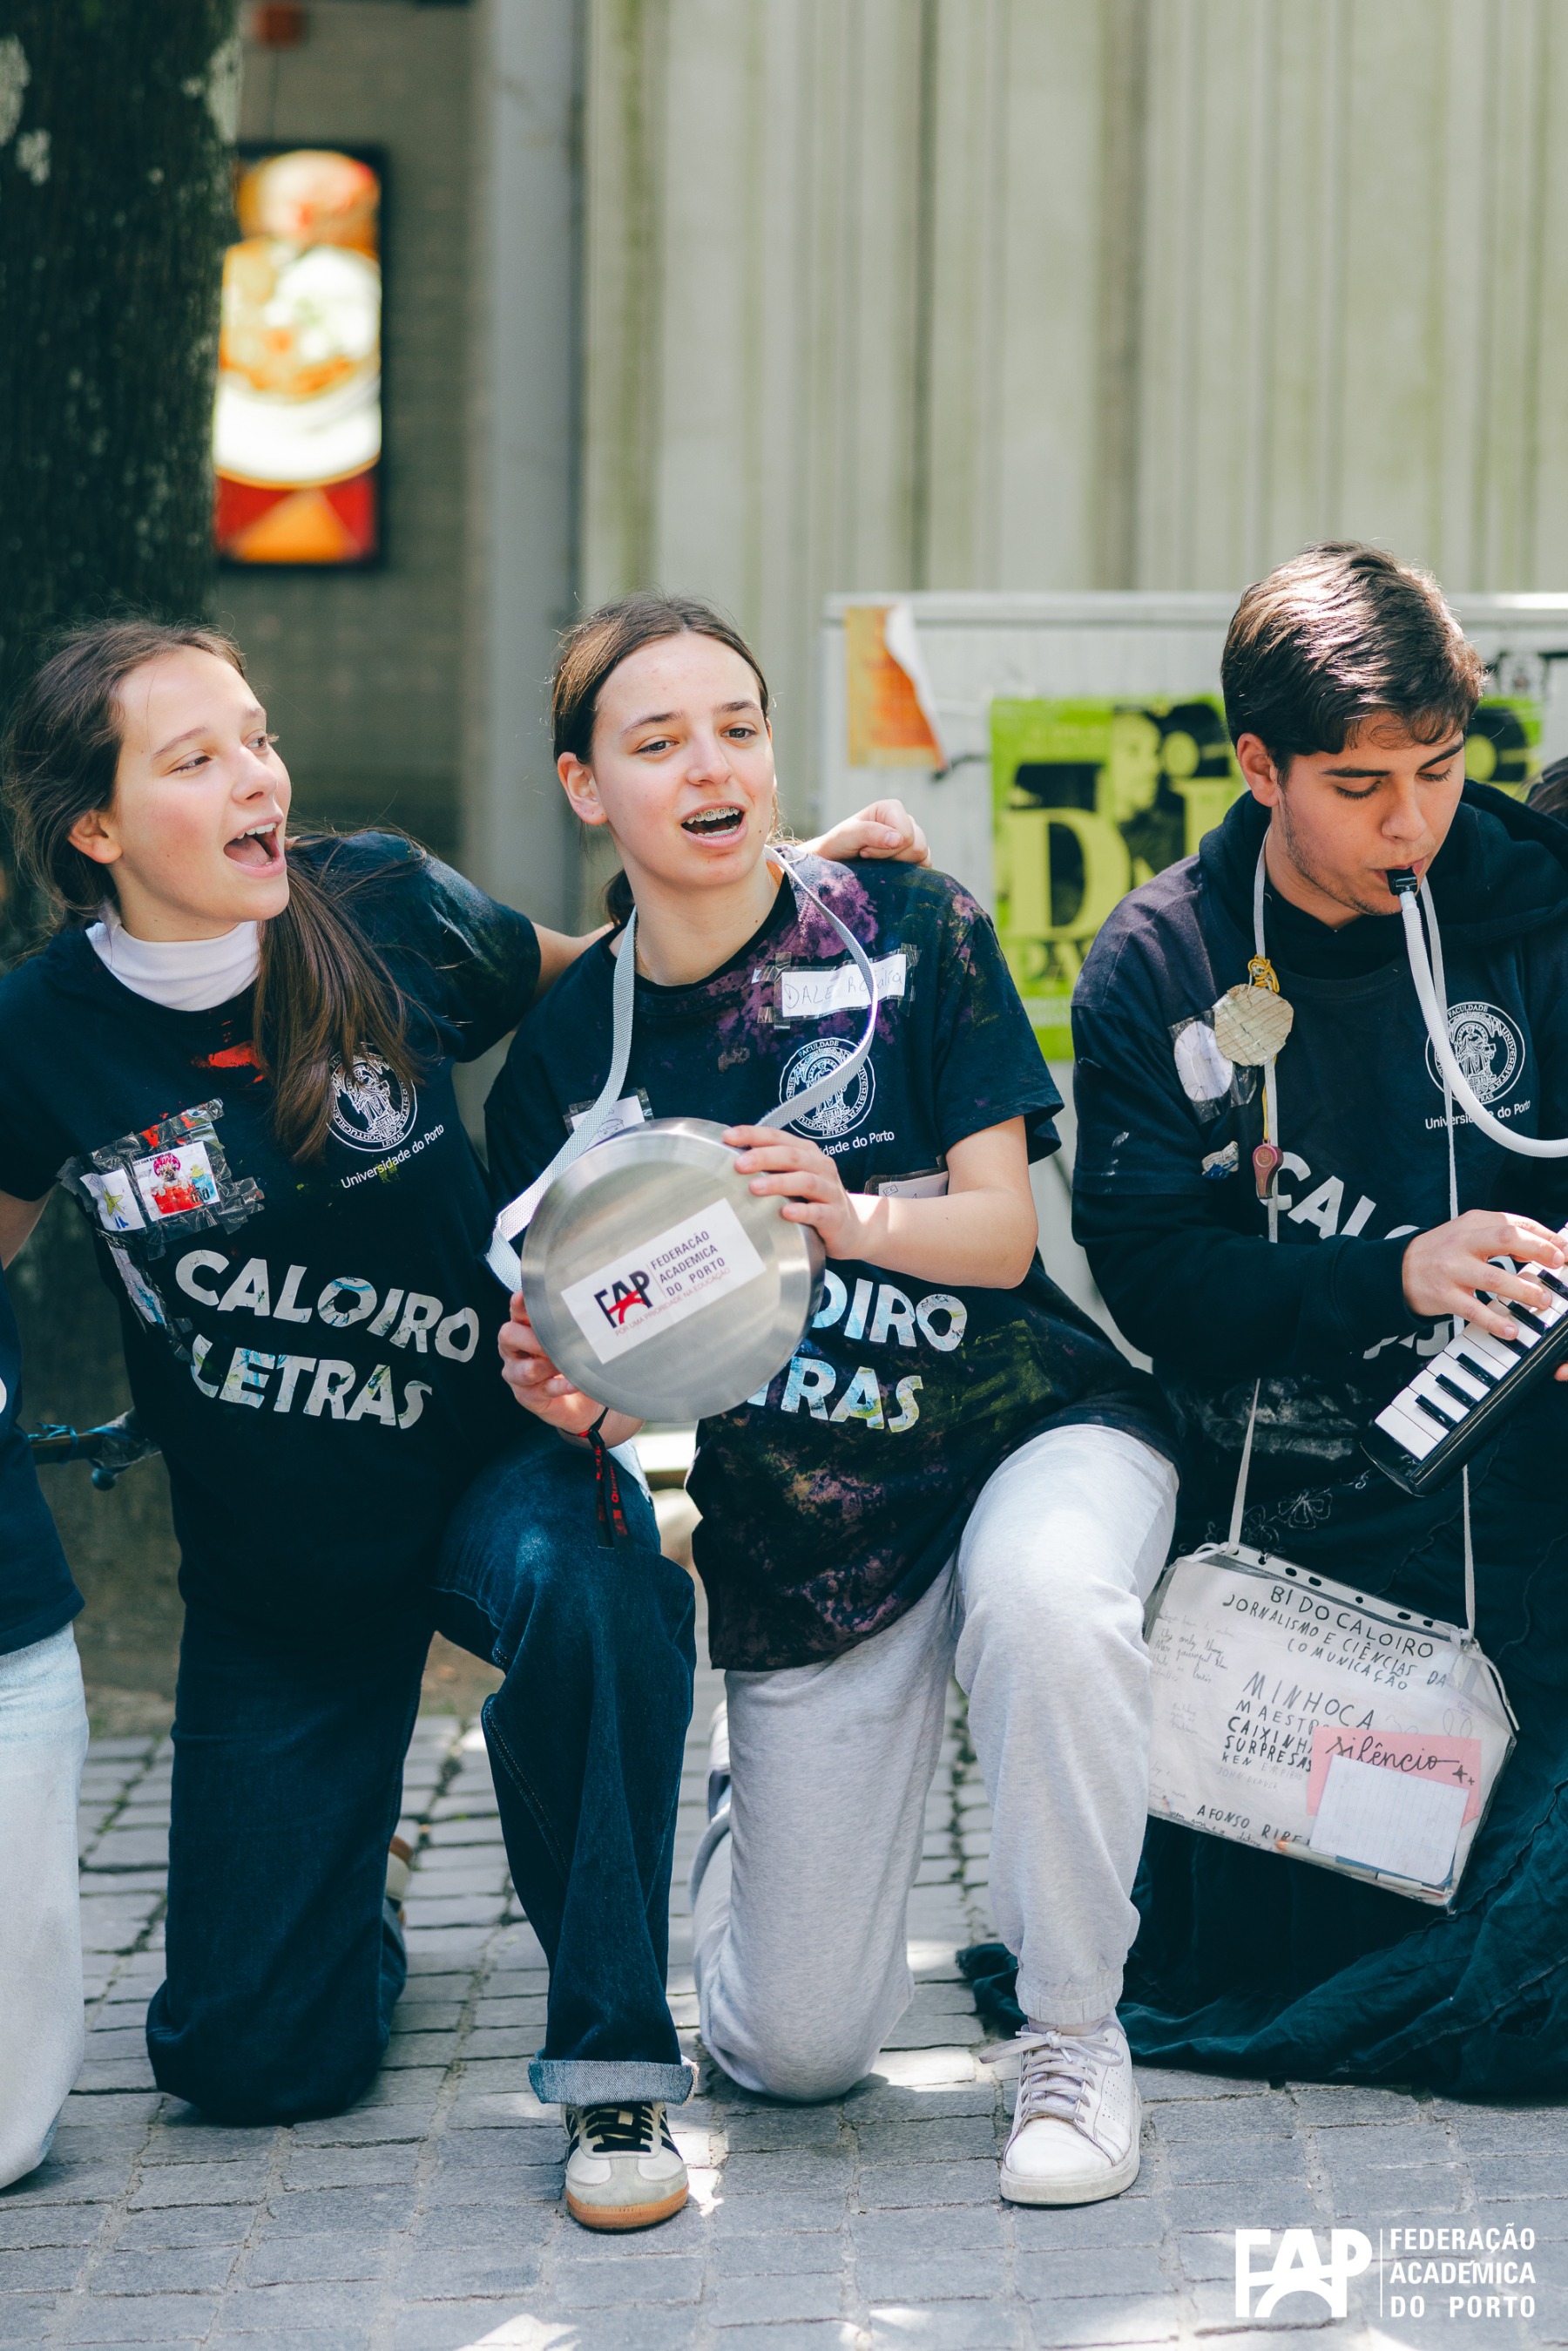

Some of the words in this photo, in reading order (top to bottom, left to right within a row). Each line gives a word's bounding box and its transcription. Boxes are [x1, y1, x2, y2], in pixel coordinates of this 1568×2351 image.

[783, 983, 834, 1009] DALE
[848, 969, 902, 993] Roalía
[1447, 1004, 1490, 1019] FACULDADE
[798, 1040, 840, 1059] FACULDADE
[841, 1067, 868, 1122] IVERSITAS
[1476, 1092, 1495, 1103] TRAS
[821, 1123, 848, 1137] LETRAS
[1424, 1109, 1495, 1130] Universie
[1497, 1106, 1511, 1119] do
[1513, 1100, 1531, 1115] Porto
[341, 1149, 412, 1189] Universidade
[411, 1140, 425, 1155] do
[424, 1123, 445, 1145] Porto
[382, 1130, 406, 1148] LETRAS
[852, 1135, 868, 1148] do
[869, 1129, 896, 1144] Porto
[650, 1230, 710, 1270] FEDERAÇÃO
[666, 1282, 683, 1297] DO
[689, 1257, 726, 1284] PORTO
[175, 1250, 479, 1362] CALOIRO
[593, 1270, 654, 1329] FAP
[812, 1269, 968, 1352] OIRO
[614, 1325, 631, 1338] POR
[629, 1317, 645, 1330] UMA
[190, 1334, 432, 1429] LETRAS
[1222, 1594, 1319, 1637] JORNALISMO
[1323, 1631, 1336, 1645] E
[1342, 1637, 1418, 1677] CIÊNCIAS
[1426, 1670, 1448, 1688] DA
[1270, 1585, 1294, 1605] BI
[1298, 1596, 1330, 1621] DO
[1335, 1612, 1434, 1658] CALOIRO
[1287, 1637, 1408, 1690] COMUNICAÇÃO
[1235, 1699, 1330, 1735] MAESTR
[1242, 1670, 1375, 1731] MINHOCA
[1325, 1735, 1460, 1772] silêncio
[1196, 1805, 1250, 1829] AFONSO
